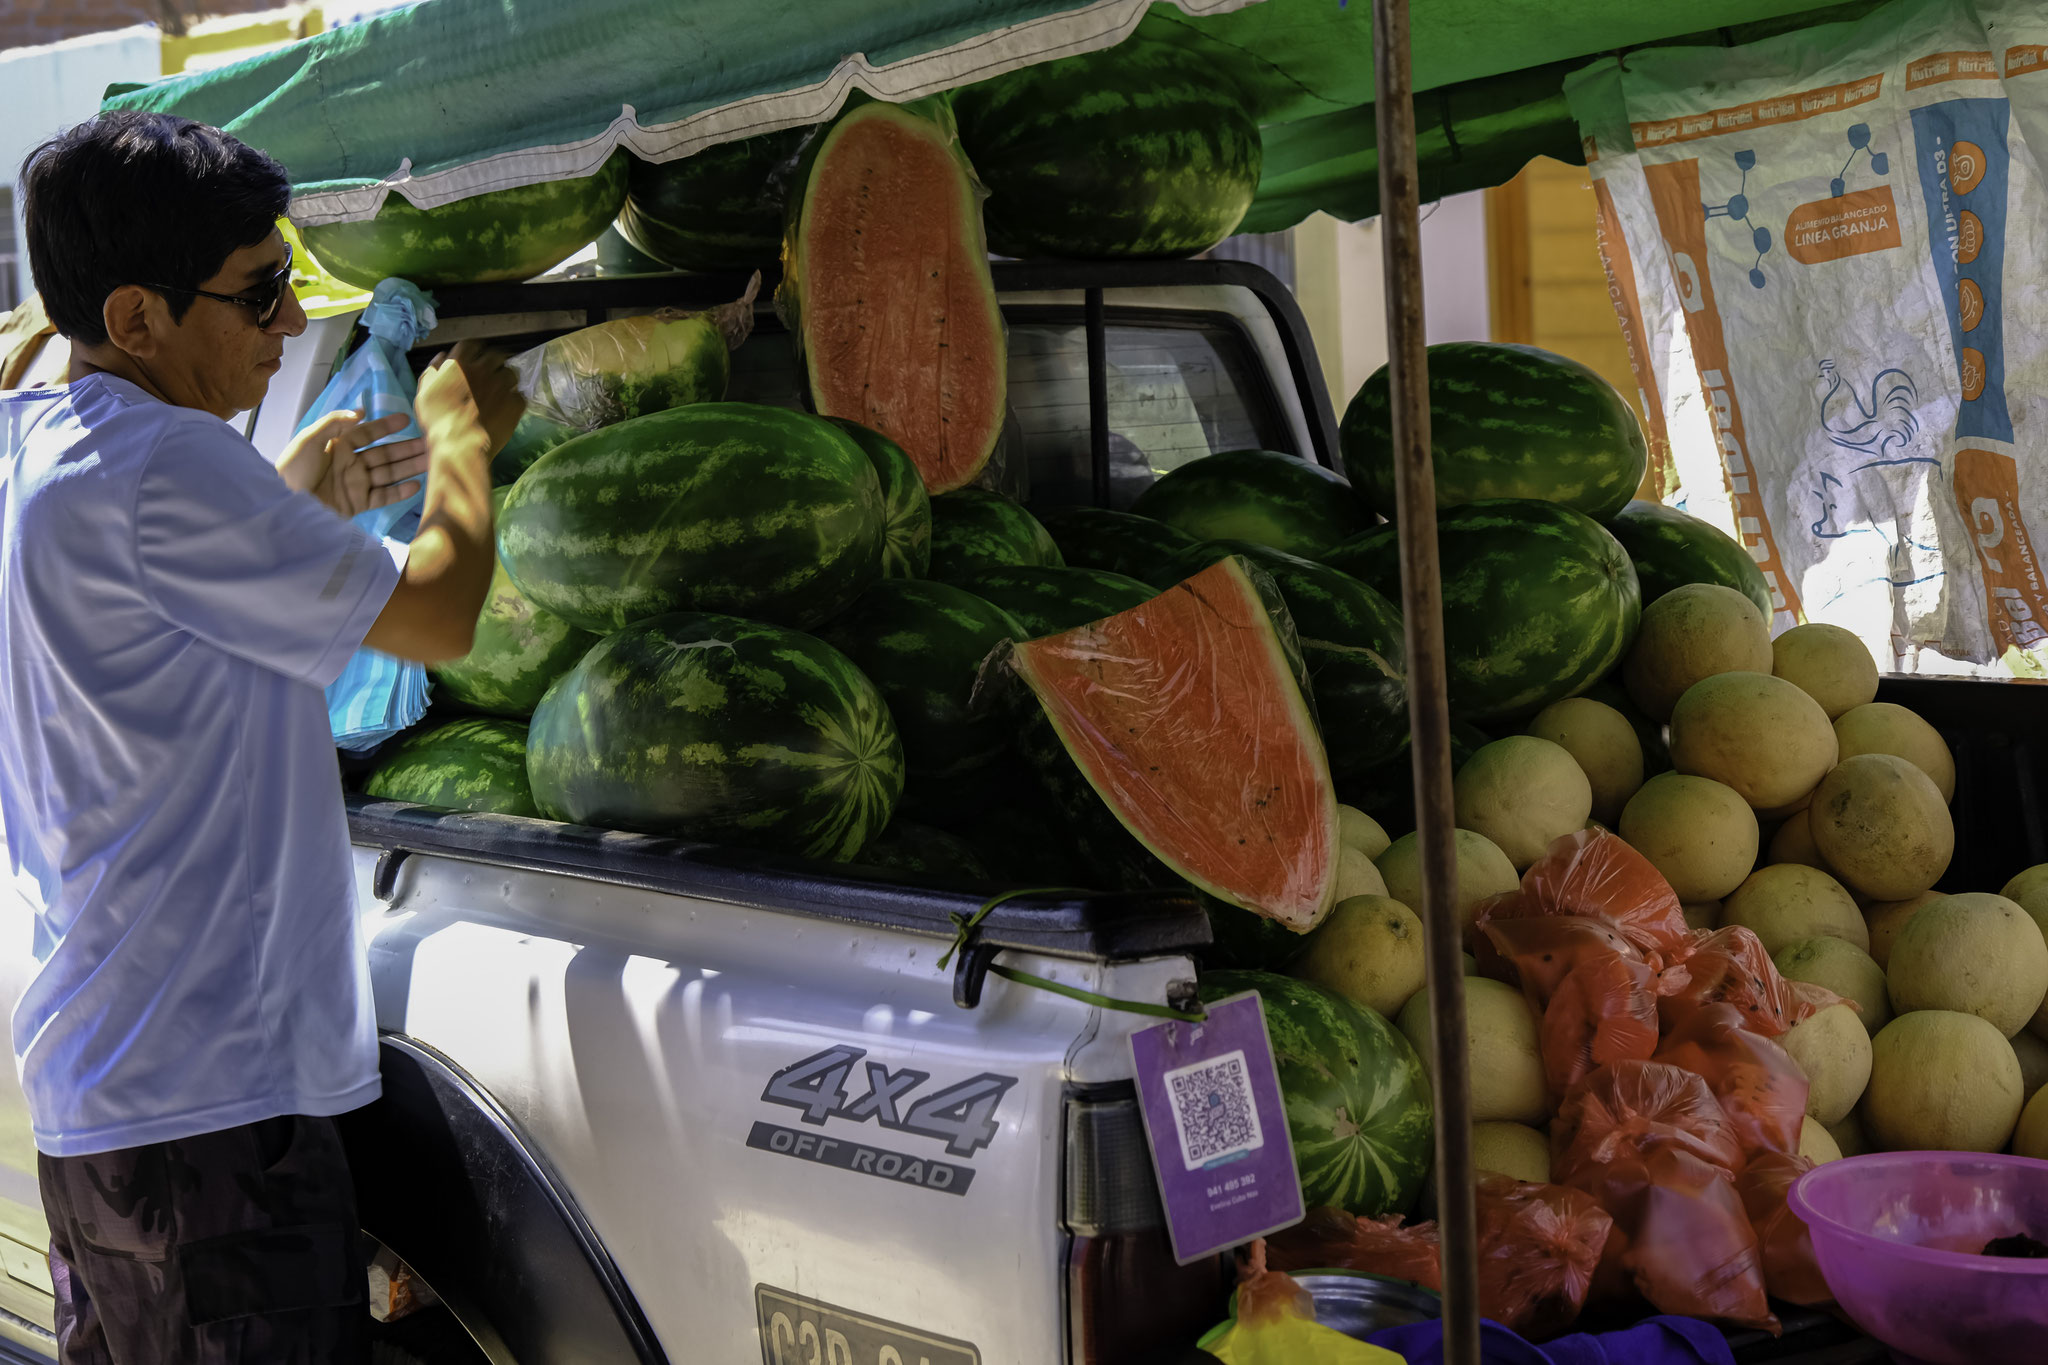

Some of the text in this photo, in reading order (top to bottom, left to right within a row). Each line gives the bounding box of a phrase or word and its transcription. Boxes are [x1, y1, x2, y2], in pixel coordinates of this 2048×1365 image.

[1934, 150, 1947, 175] D3
[1830, 204, 1888, 223] BALANCEADO
[1795, 216, 1889, 247] LINEA GRANJA
[851, 1148, 954, 1189] ROAD
